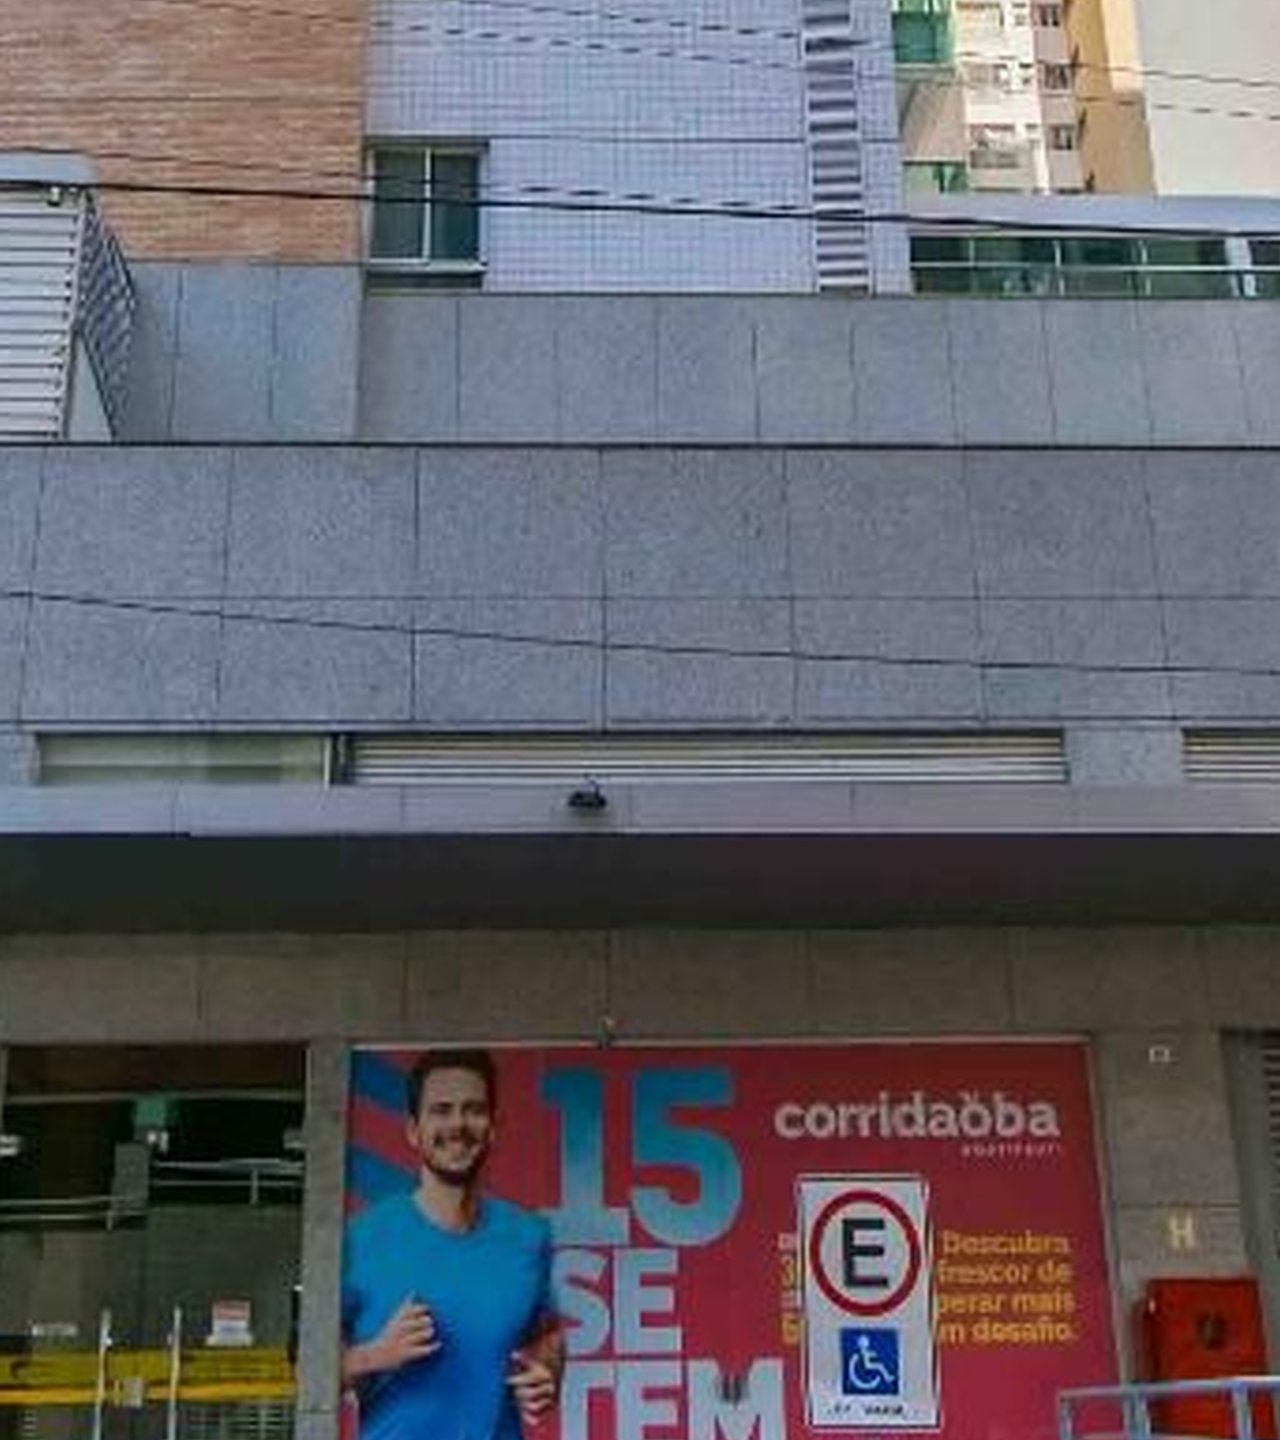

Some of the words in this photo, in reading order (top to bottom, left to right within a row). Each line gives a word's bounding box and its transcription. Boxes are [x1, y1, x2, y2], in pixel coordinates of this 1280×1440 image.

[540, 1065, 743, 1247] 15
[551, 1245, 683, 1356] SE
[842, 1217, 890, 1289] E
